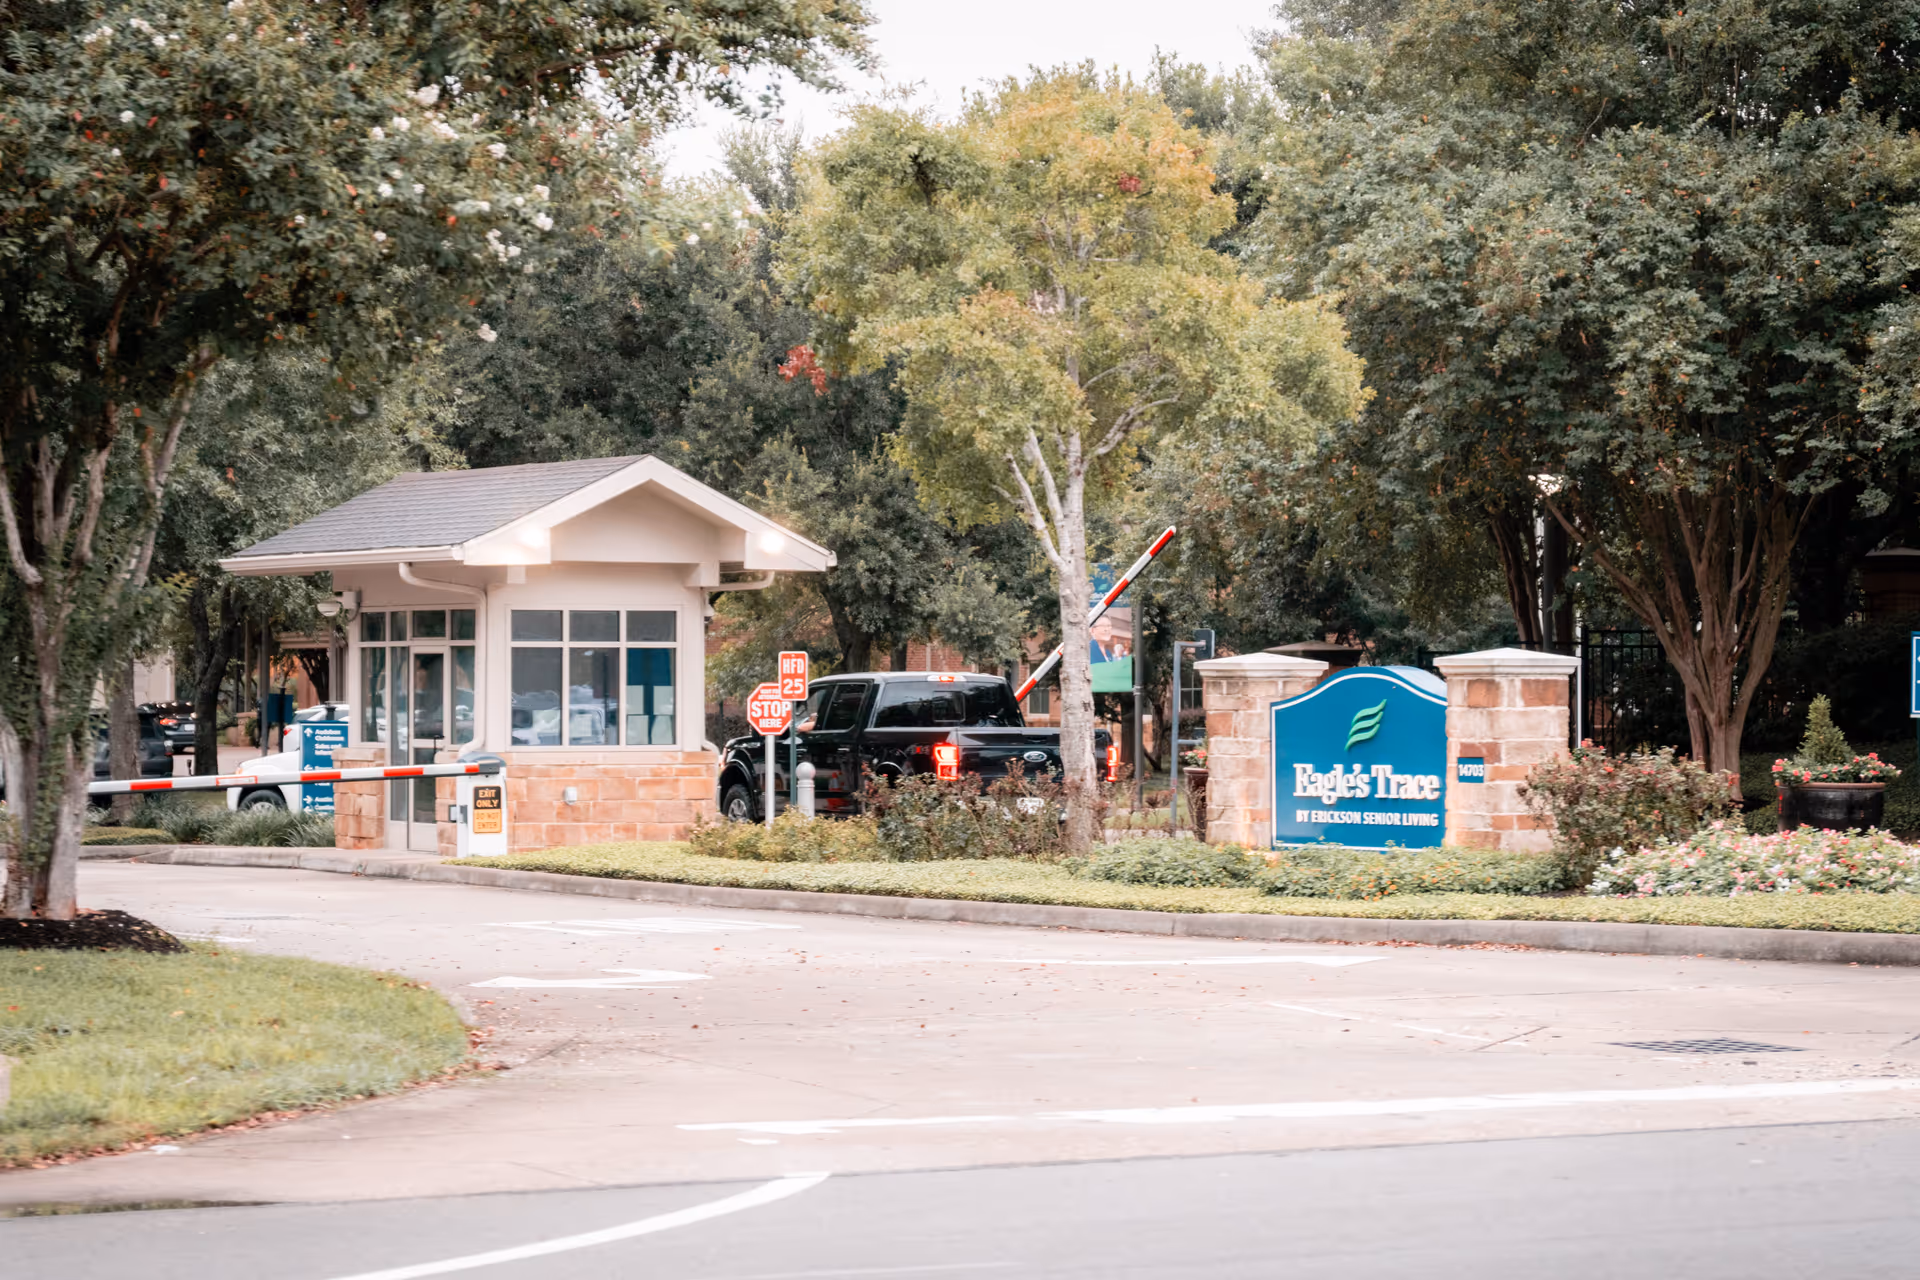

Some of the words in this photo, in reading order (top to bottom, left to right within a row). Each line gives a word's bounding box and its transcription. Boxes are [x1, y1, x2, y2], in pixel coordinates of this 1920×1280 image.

[782, 658, 804, 674] HFD
[783, 678, 804, 694] 25
[751, 700, 792, 718] STOP
[759, 718, 783, 728] HERE
[1458, 763, 1484, 777] 14703
[1293, 763, 1370, 805] Eagle's
[1371, 764, 1440, 800] Trace
[478, 789, 497, 798] EXIT
[476, 799, 499, 808] ONLY
[1296, 810, 1310, 823] BY
[1311, 810, 1362, 824] ERICKSON
[1363, 812, 1401, 825] SENIOR
[1402, 812, 1439, 827] LIVING
